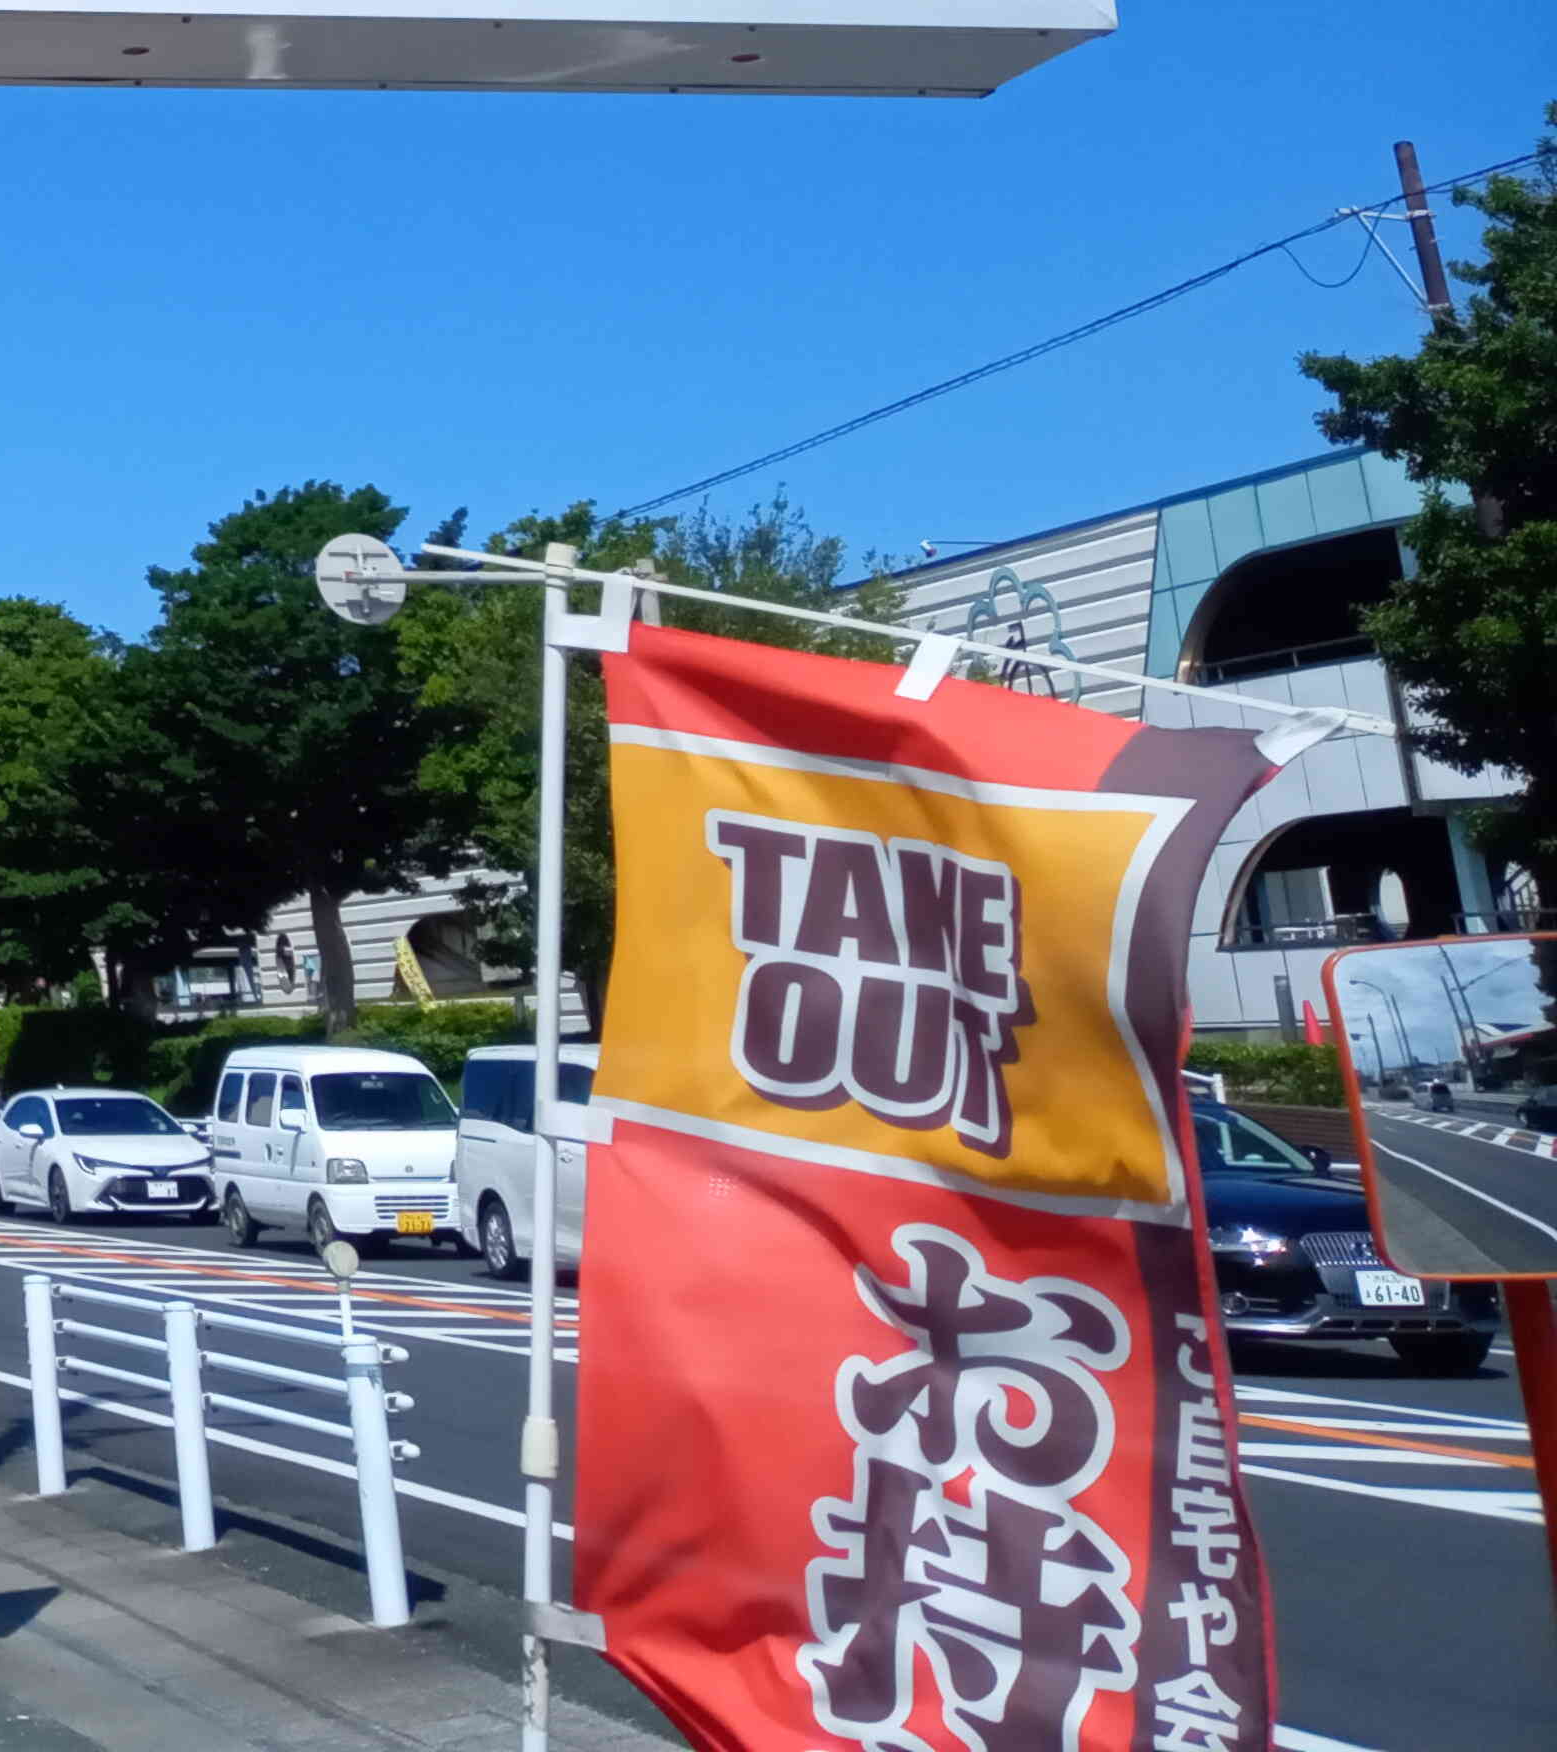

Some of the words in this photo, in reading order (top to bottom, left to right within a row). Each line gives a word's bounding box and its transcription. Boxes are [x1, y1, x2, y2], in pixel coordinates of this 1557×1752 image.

[711, 814, 1015, 1005] TAKE
[735, 958, 997, 1134] OUT
[1374, 1285, 1421, 1302] 61-40
[805, 1236, 1131, 1752] お持
